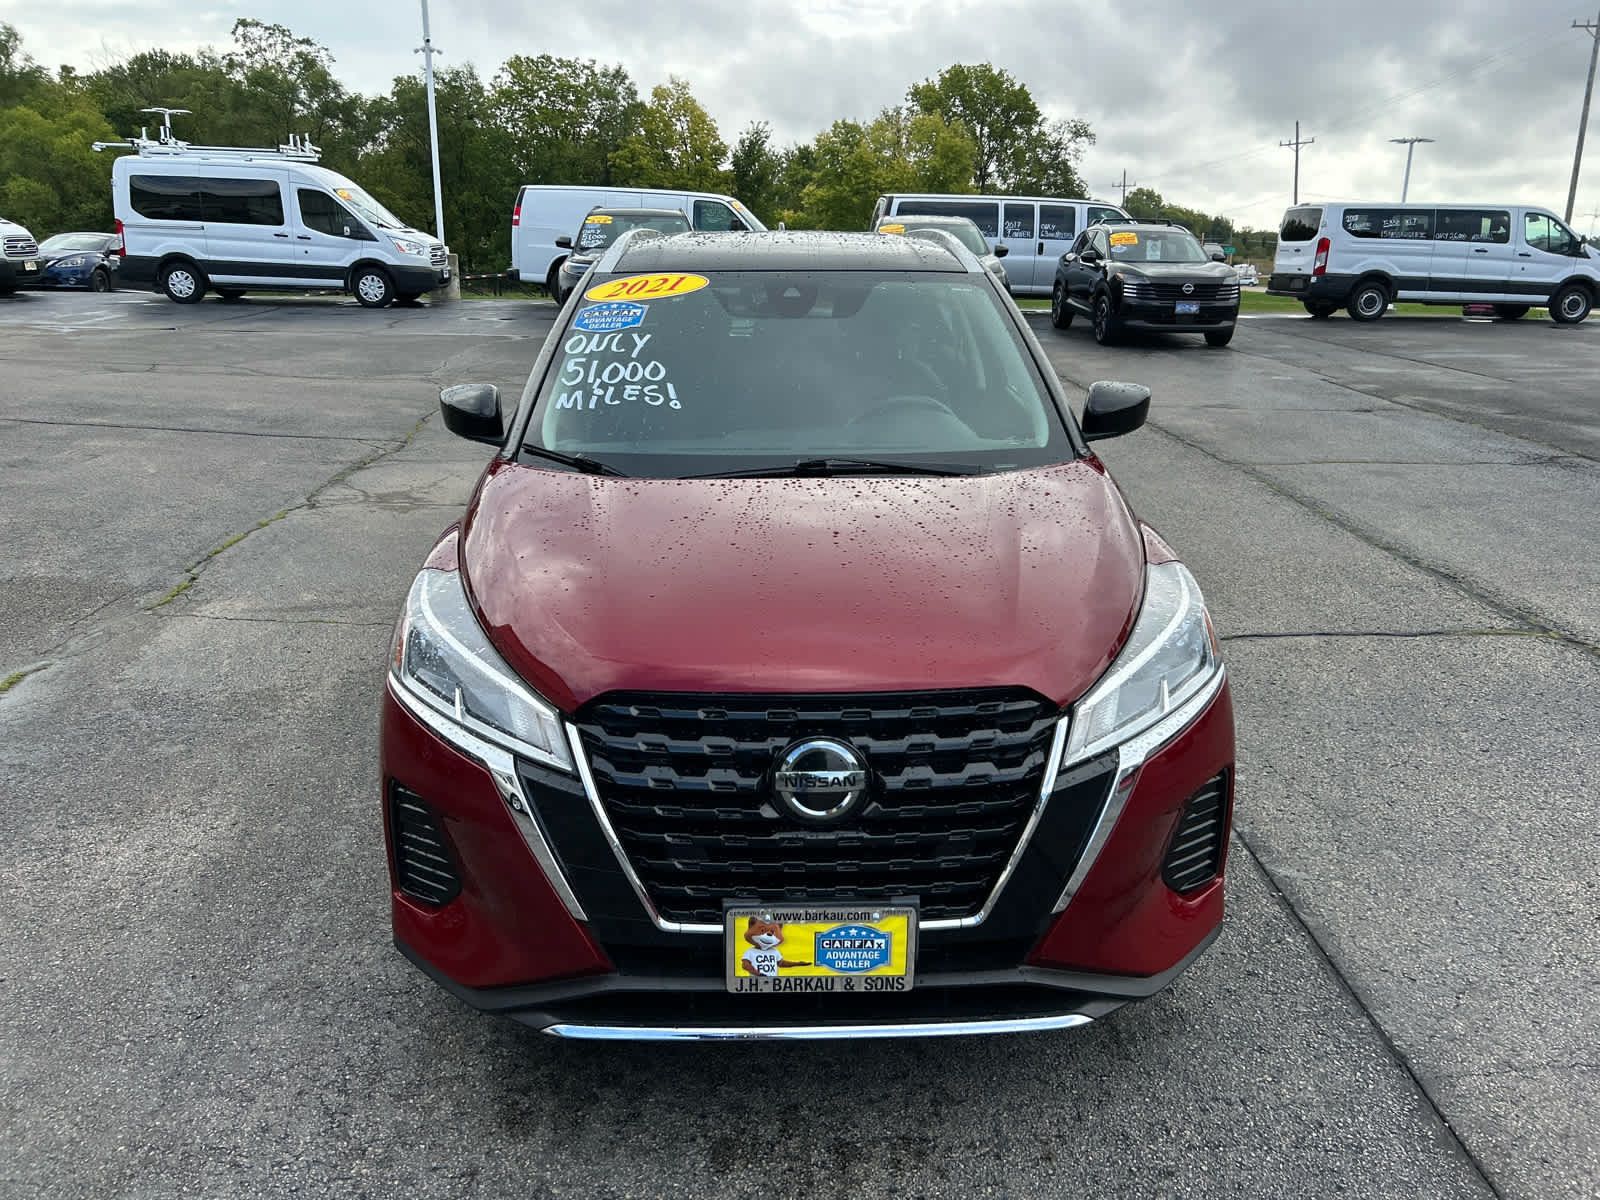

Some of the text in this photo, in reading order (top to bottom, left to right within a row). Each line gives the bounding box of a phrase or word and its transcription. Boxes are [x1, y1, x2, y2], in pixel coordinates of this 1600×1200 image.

[603, 276, 687, 298] 2021
[583, 316, 633, 325] ADVANTAGE
[564, 333, 652, 358] ONLY
[561, 357, 666, 390] 51,000
[785, 776, 857, 788] NISSAN
[772, 910, 871, 921] www.barkau.com
[822, 939, 886, 949] CARFAX
[755, 955, 776, 963] CAR
[826, 951, 880, 959] ADVANTAGE
[756, 964, 776, 972] FOX
[835, 960, 870, 968] DEALER
[772, 977, 835, 991] BARKAU
[844, 977, 855, 990] &
[864, 977, 905, 991] SONS
